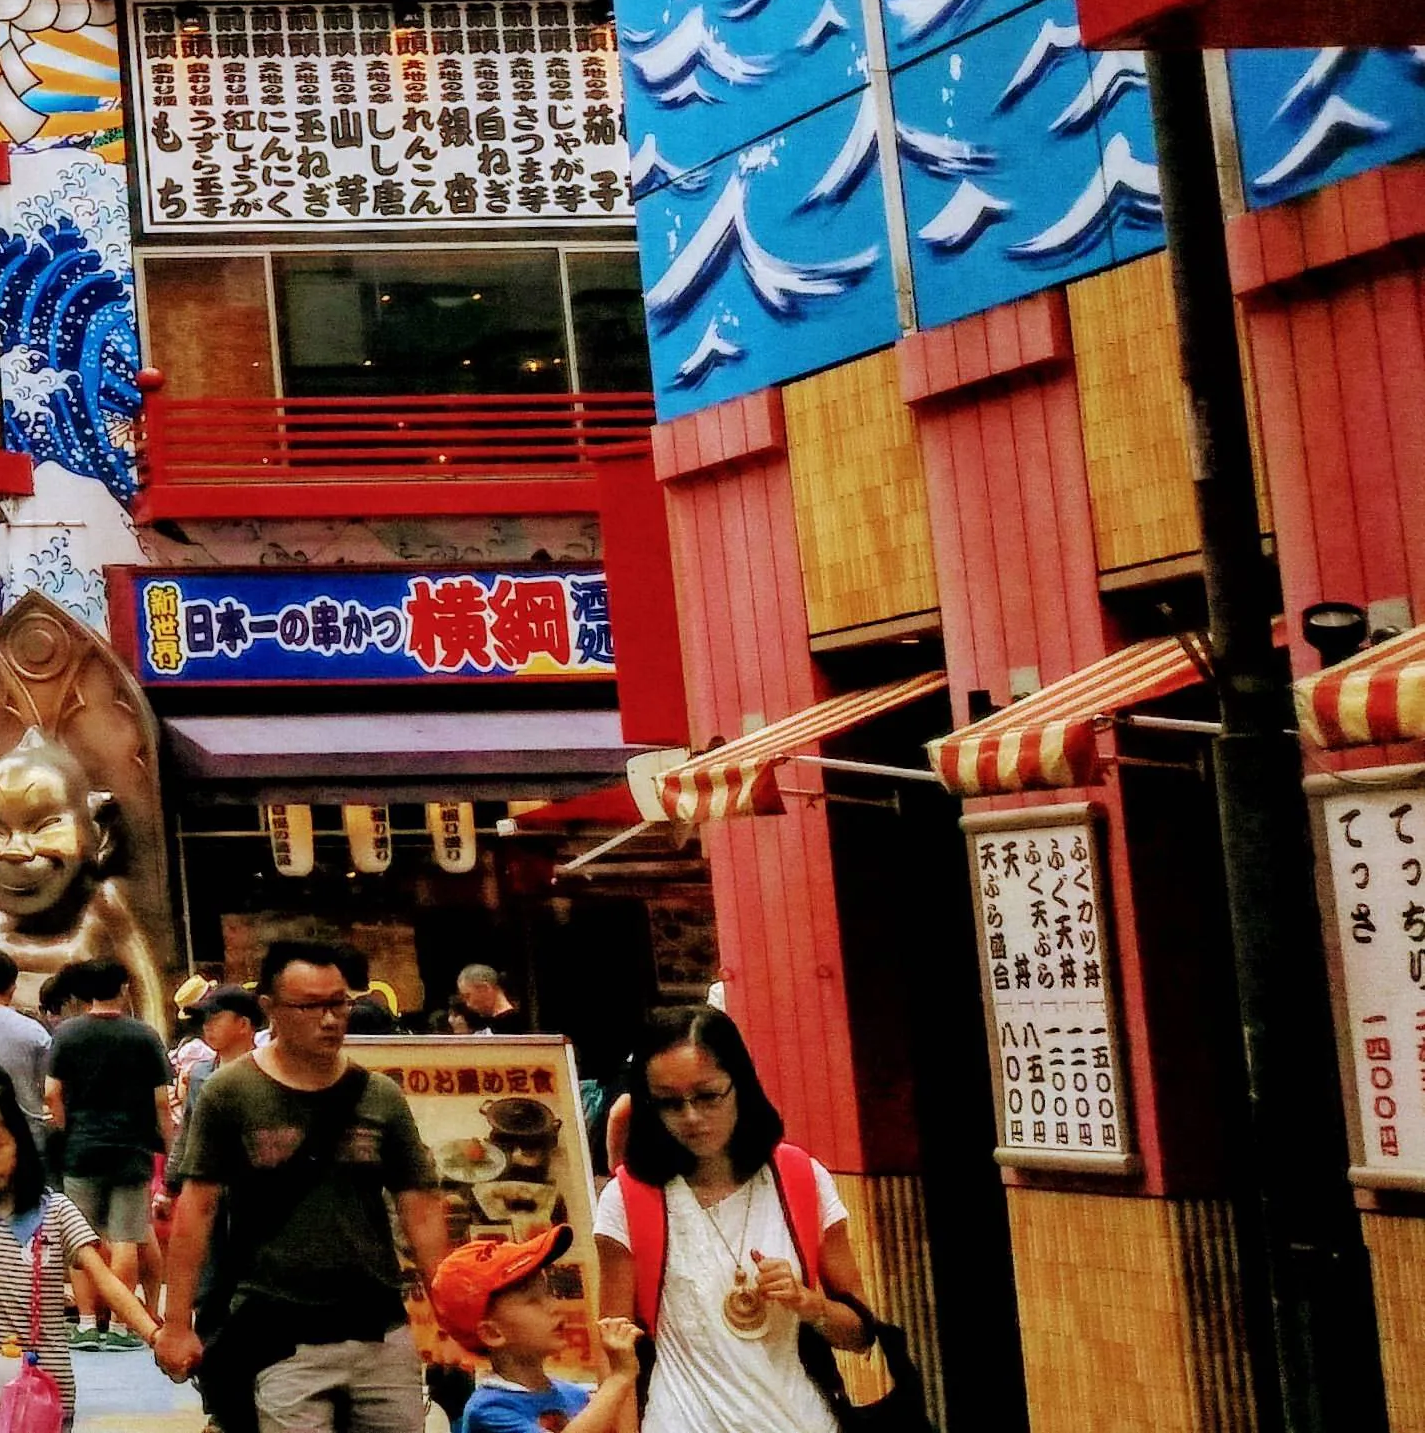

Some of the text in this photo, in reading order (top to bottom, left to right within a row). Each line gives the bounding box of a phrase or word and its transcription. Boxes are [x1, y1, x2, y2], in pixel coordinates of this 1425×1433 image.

[151, 111, 187, 218] もち
[187, 109, 227, 218] うずら玉子
[223, 109, 263, 217] 紅しょうが
[257, 111, 296, 218] にんにく
[294, 109, 334, 217] 玉ねぎ
[331, 108, 369, 217] 山芋
[368, 108, 405, 216] しし唐
[402, 107, 443, 215] れんこん
[437, 107, 479, 214] 銀杏
[475, 106, 514, 214] 白ねぎ
[511, 105, 550, 213] さつま芋
[547, 105, 587, 213] じゃが芋
[583, 104, 623, 212] 茄子
[150, 584, 182, 670] 新世界
[185, 576, 569, 670] 日本一の串かつ 横綱
